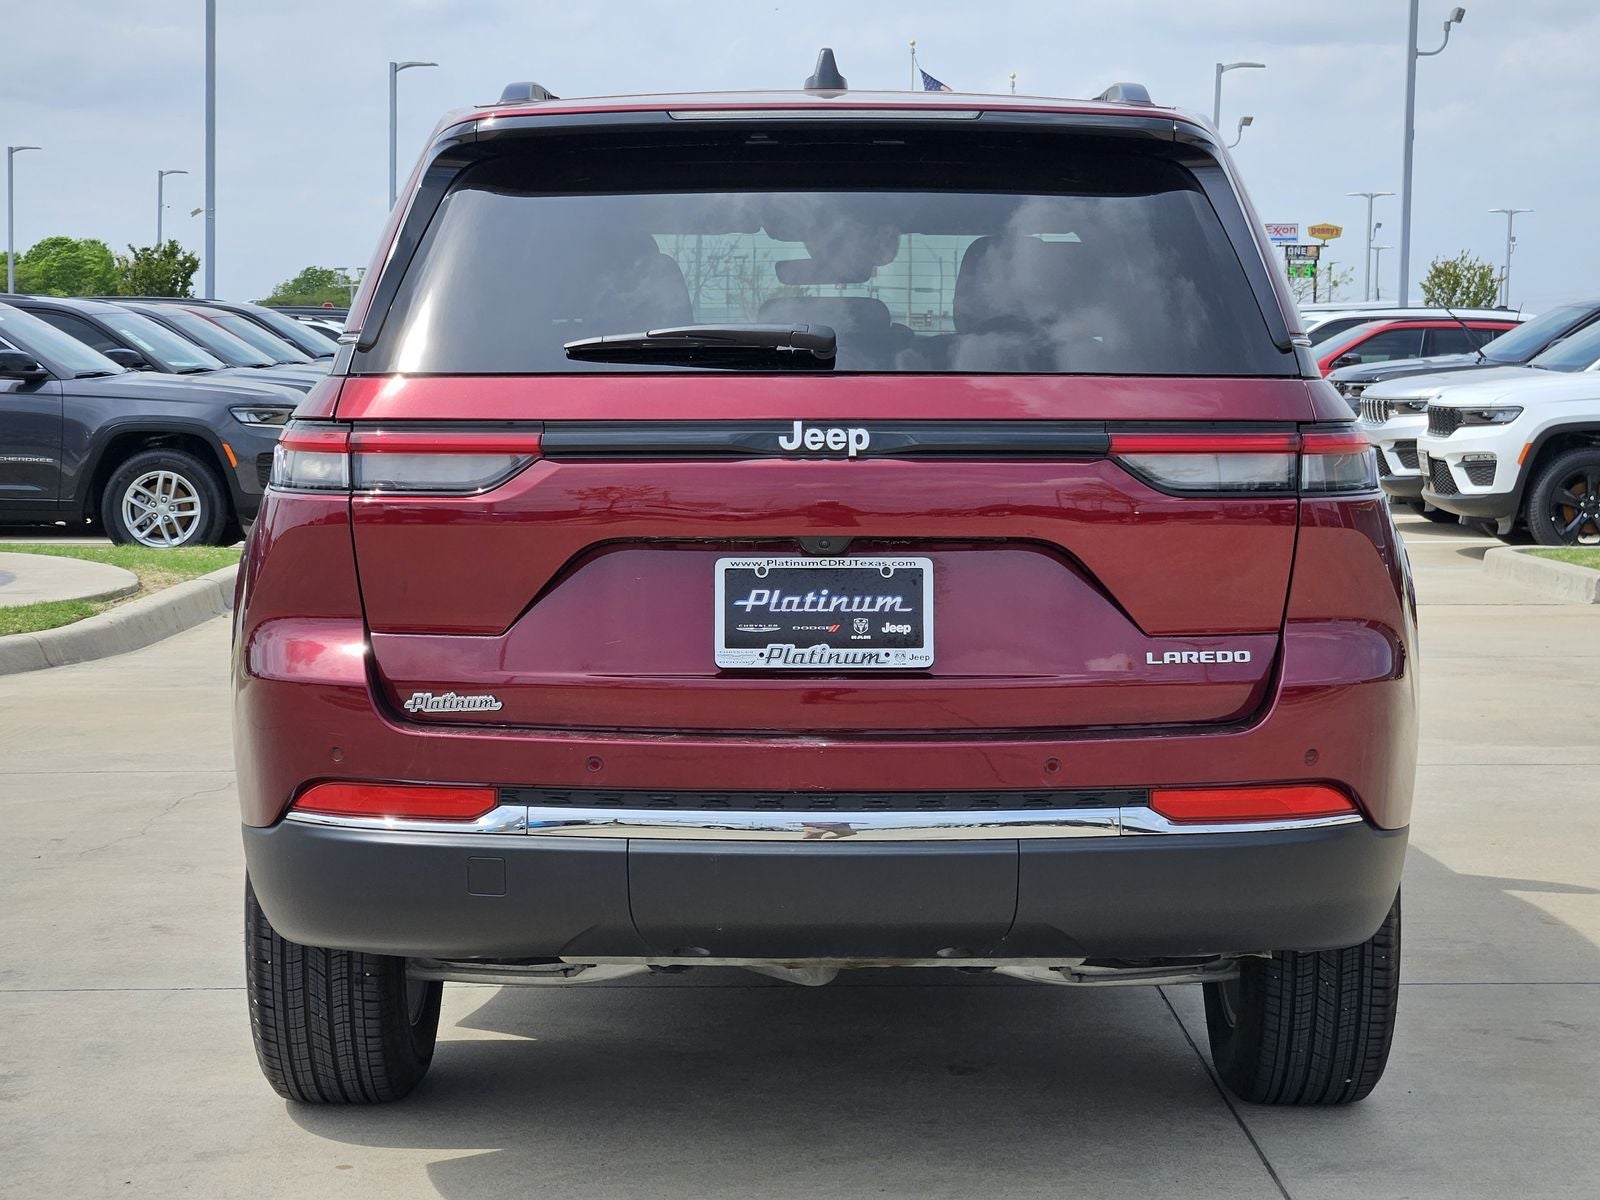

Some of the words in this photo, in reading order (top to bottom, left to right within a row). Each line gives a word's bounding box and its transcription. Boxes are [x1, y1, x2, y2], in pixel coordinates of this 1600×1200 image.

[1265, 225, 1296, 236] Exxon
[1311, 227, 1339, 235] Denny's
[778, 420, 870, 457] Jeep
[730, 559, 917, 568] www.PlatinumCDRJTexas.com
[733, 589, 913, 613] Platinum
[881, 622, 912, 635] Jeep
[765, 647, 890, 665] Platinum
[908, 653, 930, 662] Jeep
[1146, 651, 1251, 664] LAREDO
[404, 692, 501, 712] Platinum
